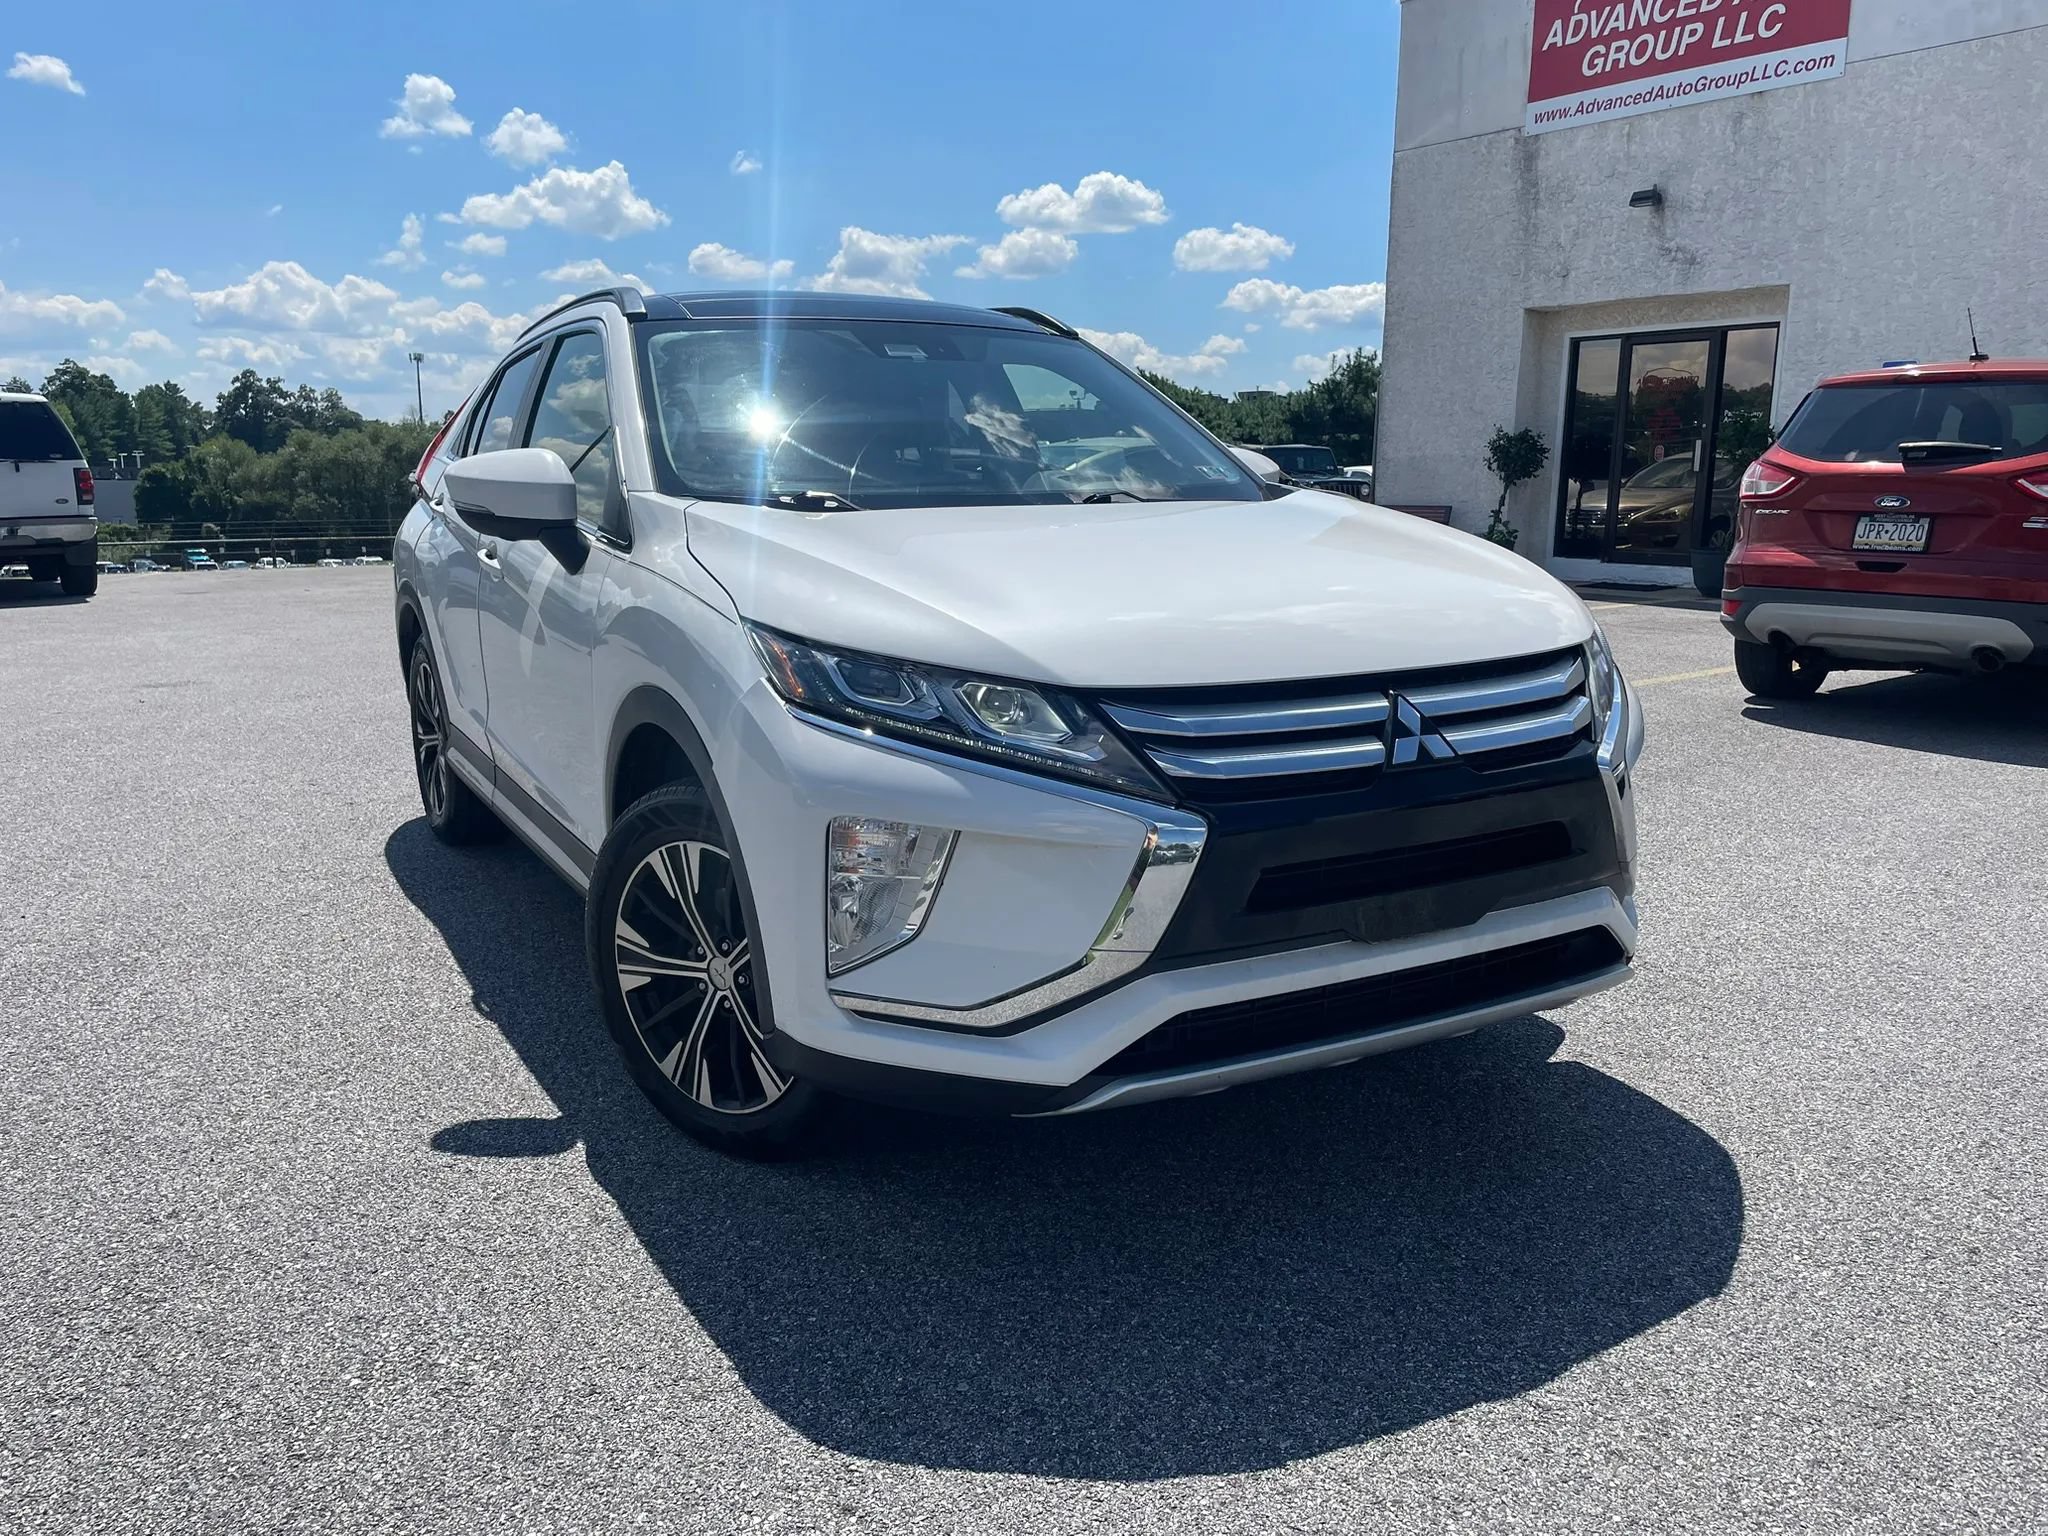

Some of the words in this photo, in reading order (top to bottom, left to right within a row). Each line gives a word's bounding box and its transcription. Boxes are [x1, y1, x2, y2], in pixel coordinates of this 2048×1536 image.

[1582, 22, 1705, 77] GROUP
[1711, 3, 1787, 49] LLC
[1533, 53, 1836, 125] www.AdvancedAutoGroupLLC.com
[1880, 497, 1901, 506] Ford
